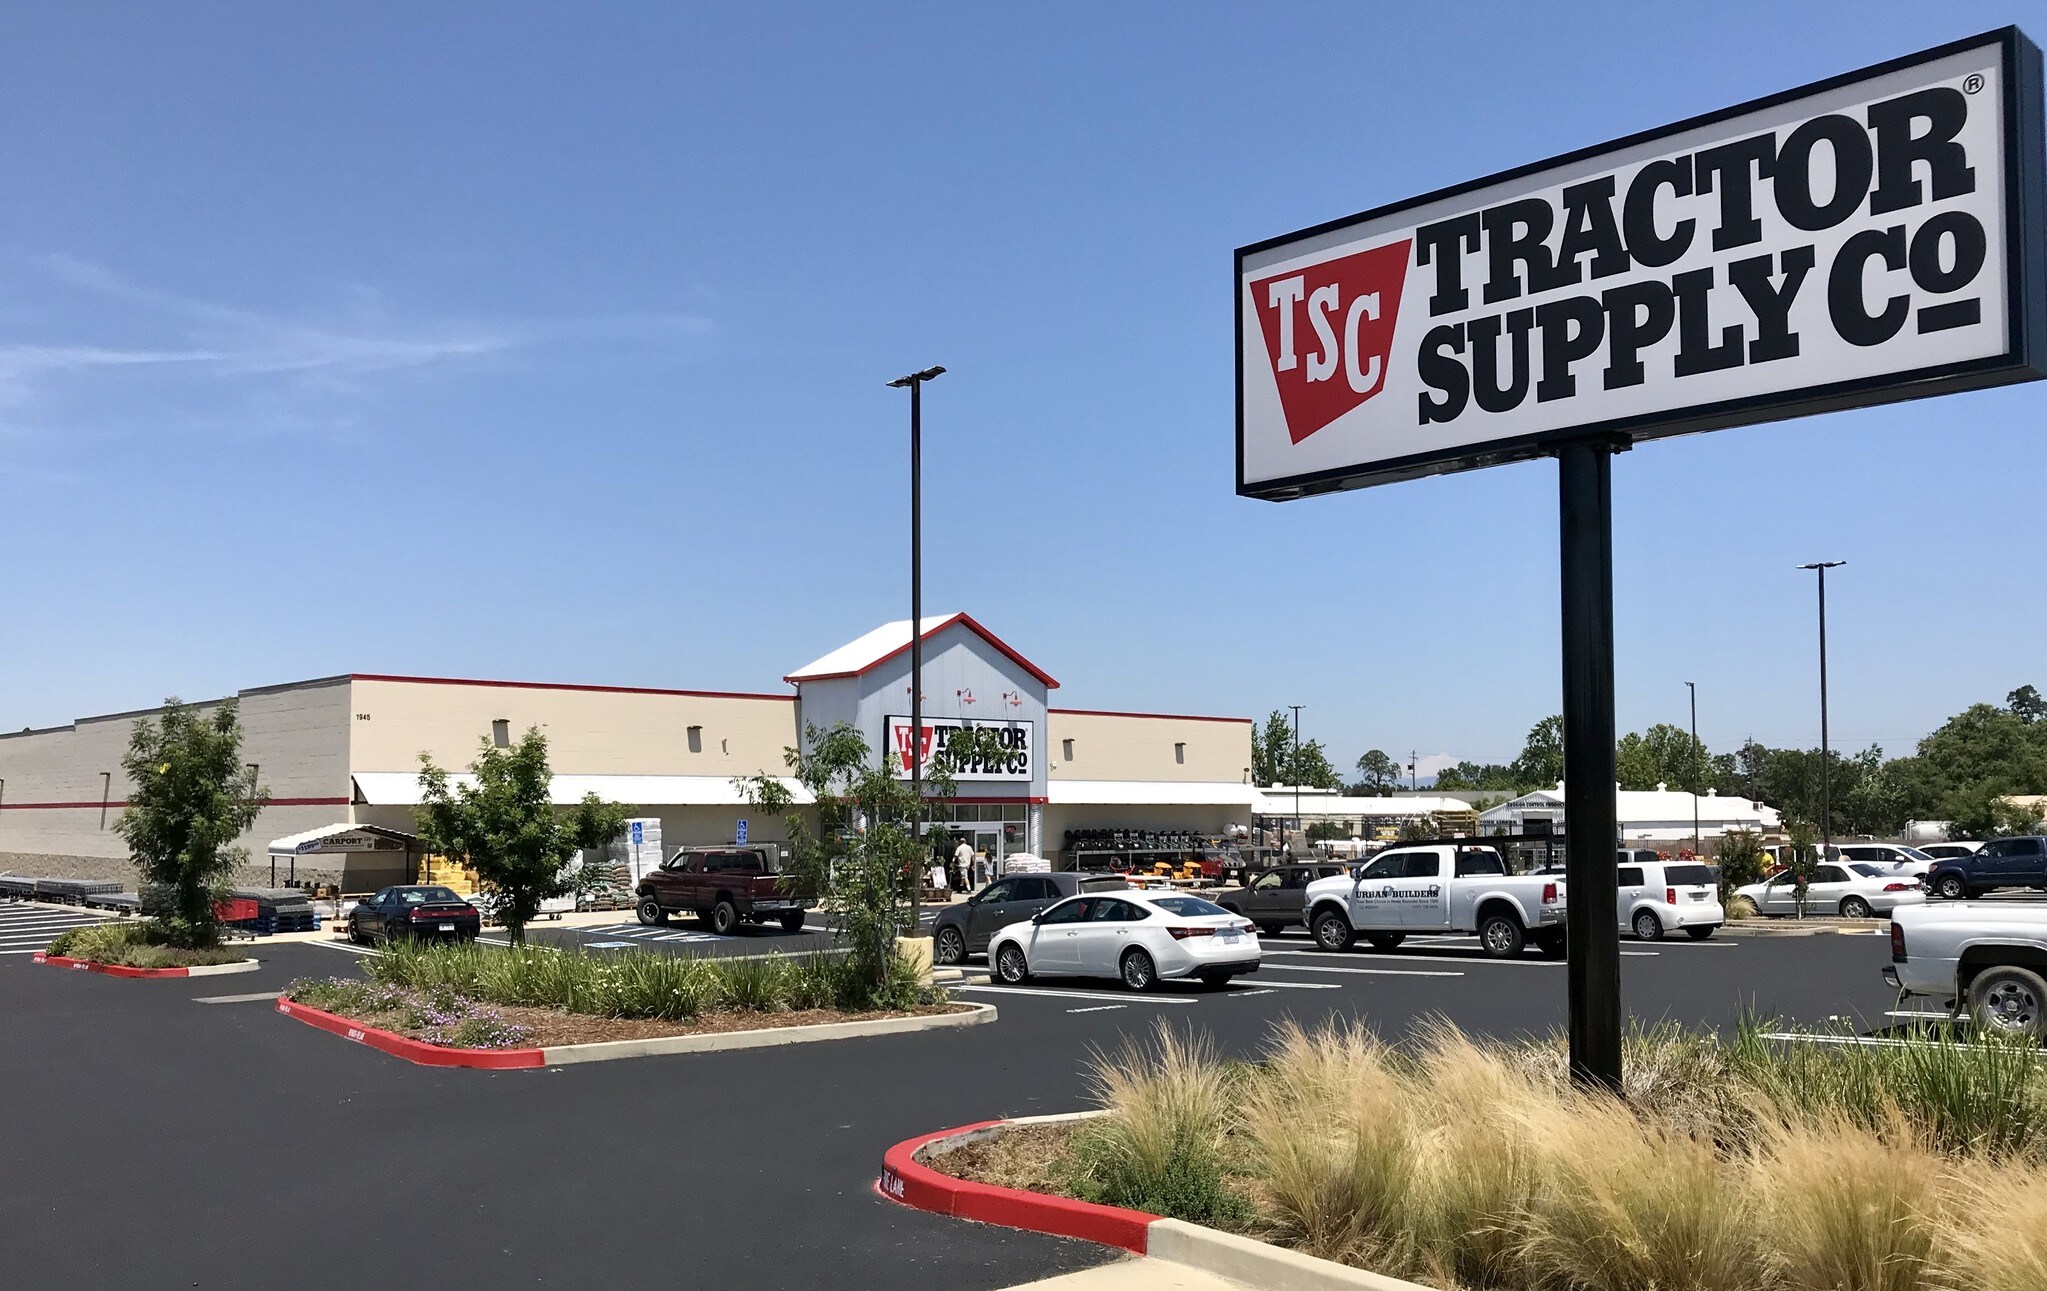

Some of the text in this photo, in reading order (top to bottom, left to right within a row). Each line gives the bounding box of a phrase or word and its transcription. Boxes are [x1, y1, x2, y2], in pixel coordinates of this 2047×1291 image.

[1416, 87, 1976, 317] TRACTOR
[1268, 275, 1381, 394] TSC
[1417, 244, 1815, 426] SUPPLY
[1355, 890, 1439, 899] URBAN BUILDERS
